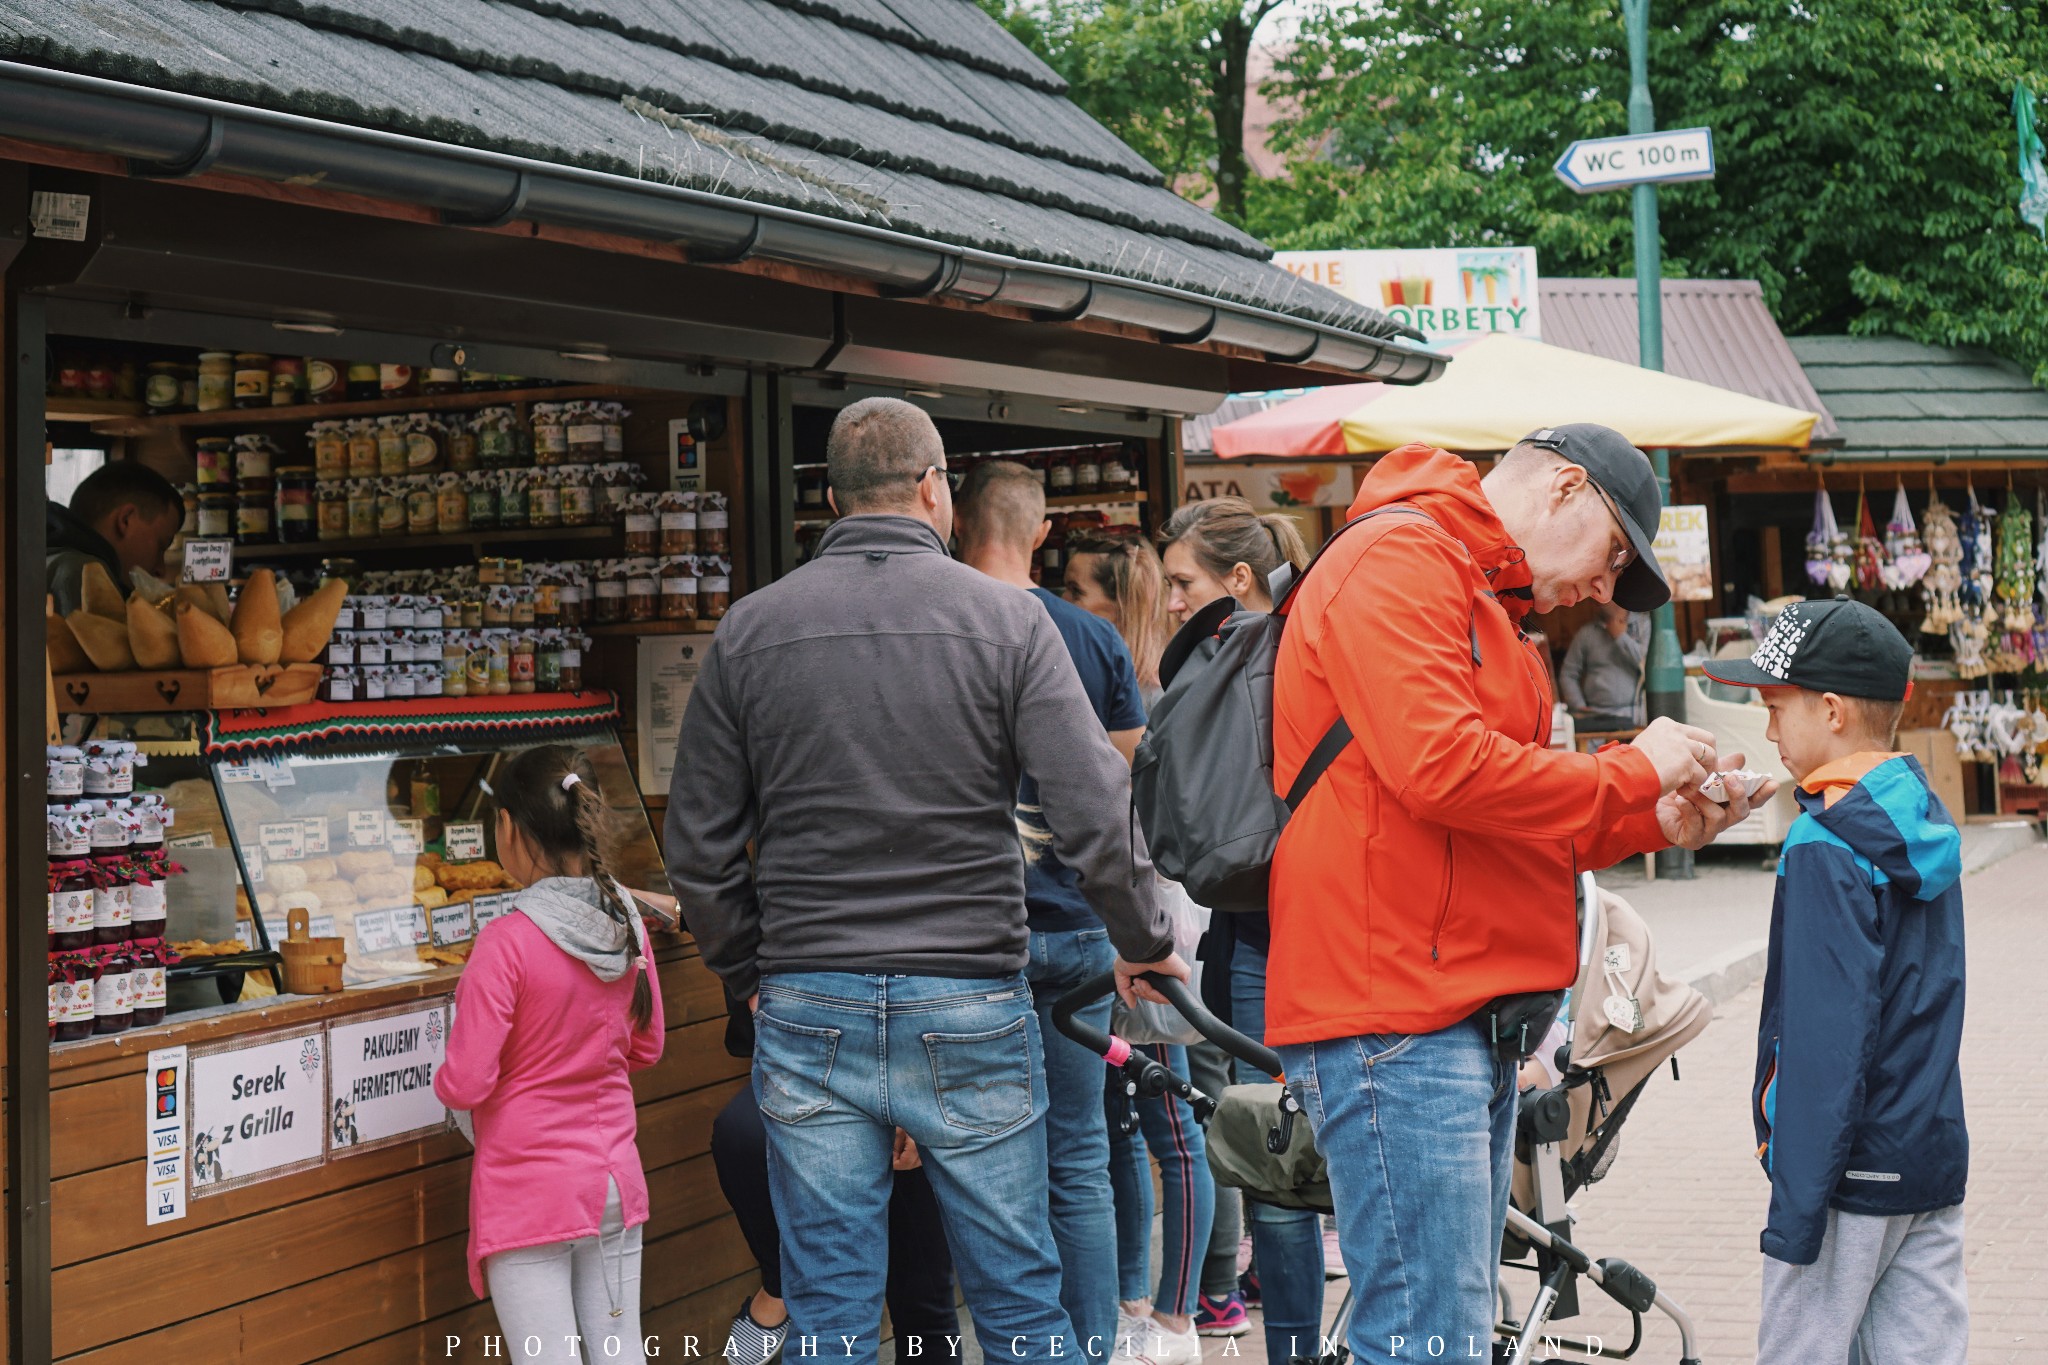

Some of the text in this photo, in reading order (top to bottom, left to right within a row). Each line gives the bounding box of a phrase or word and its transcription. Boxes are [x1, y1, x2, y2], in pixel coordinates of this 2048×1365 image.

[1584, 150, 1625, 172] WC
[1277, 261, 1342, 285] KIE
[1387, 306, 1528, 332] ORBETY
[679, 480, 698, 489] VISA
[1185, 480, 1245, 503] ATA
[1659, 511, 1704, 532] REK
[363, 1027, 420, 1062] PAKUJEMY
[232, 1065, 287, 1101] Serek
[352, 1062, 432, 1104] HERMETYCZNIE
[222, 1105, 294, 1145] z Grilla
[157, 1134, 178, 1148] VISA
[156, 1163, 176, 1177] VISA
[162, 1191, 171, 1203] V
